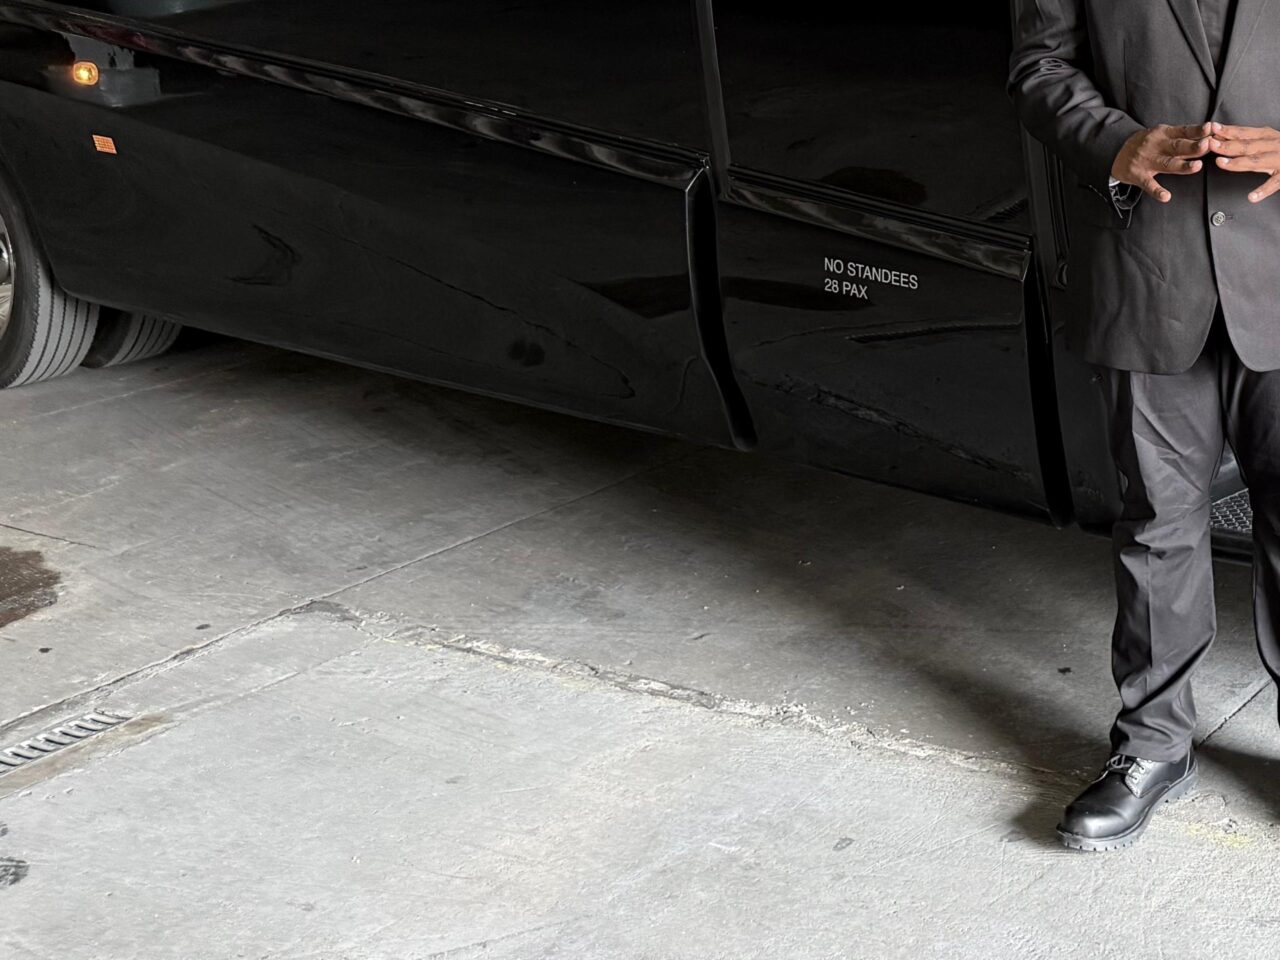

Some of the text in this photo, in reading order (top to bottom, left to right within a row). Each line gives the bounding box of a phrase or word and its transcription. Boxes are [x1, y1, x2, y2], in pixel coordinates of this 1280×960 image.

[824, 257, 918, 289] NO STANDEES
[824, 278, 868, 300] 28 PAX
